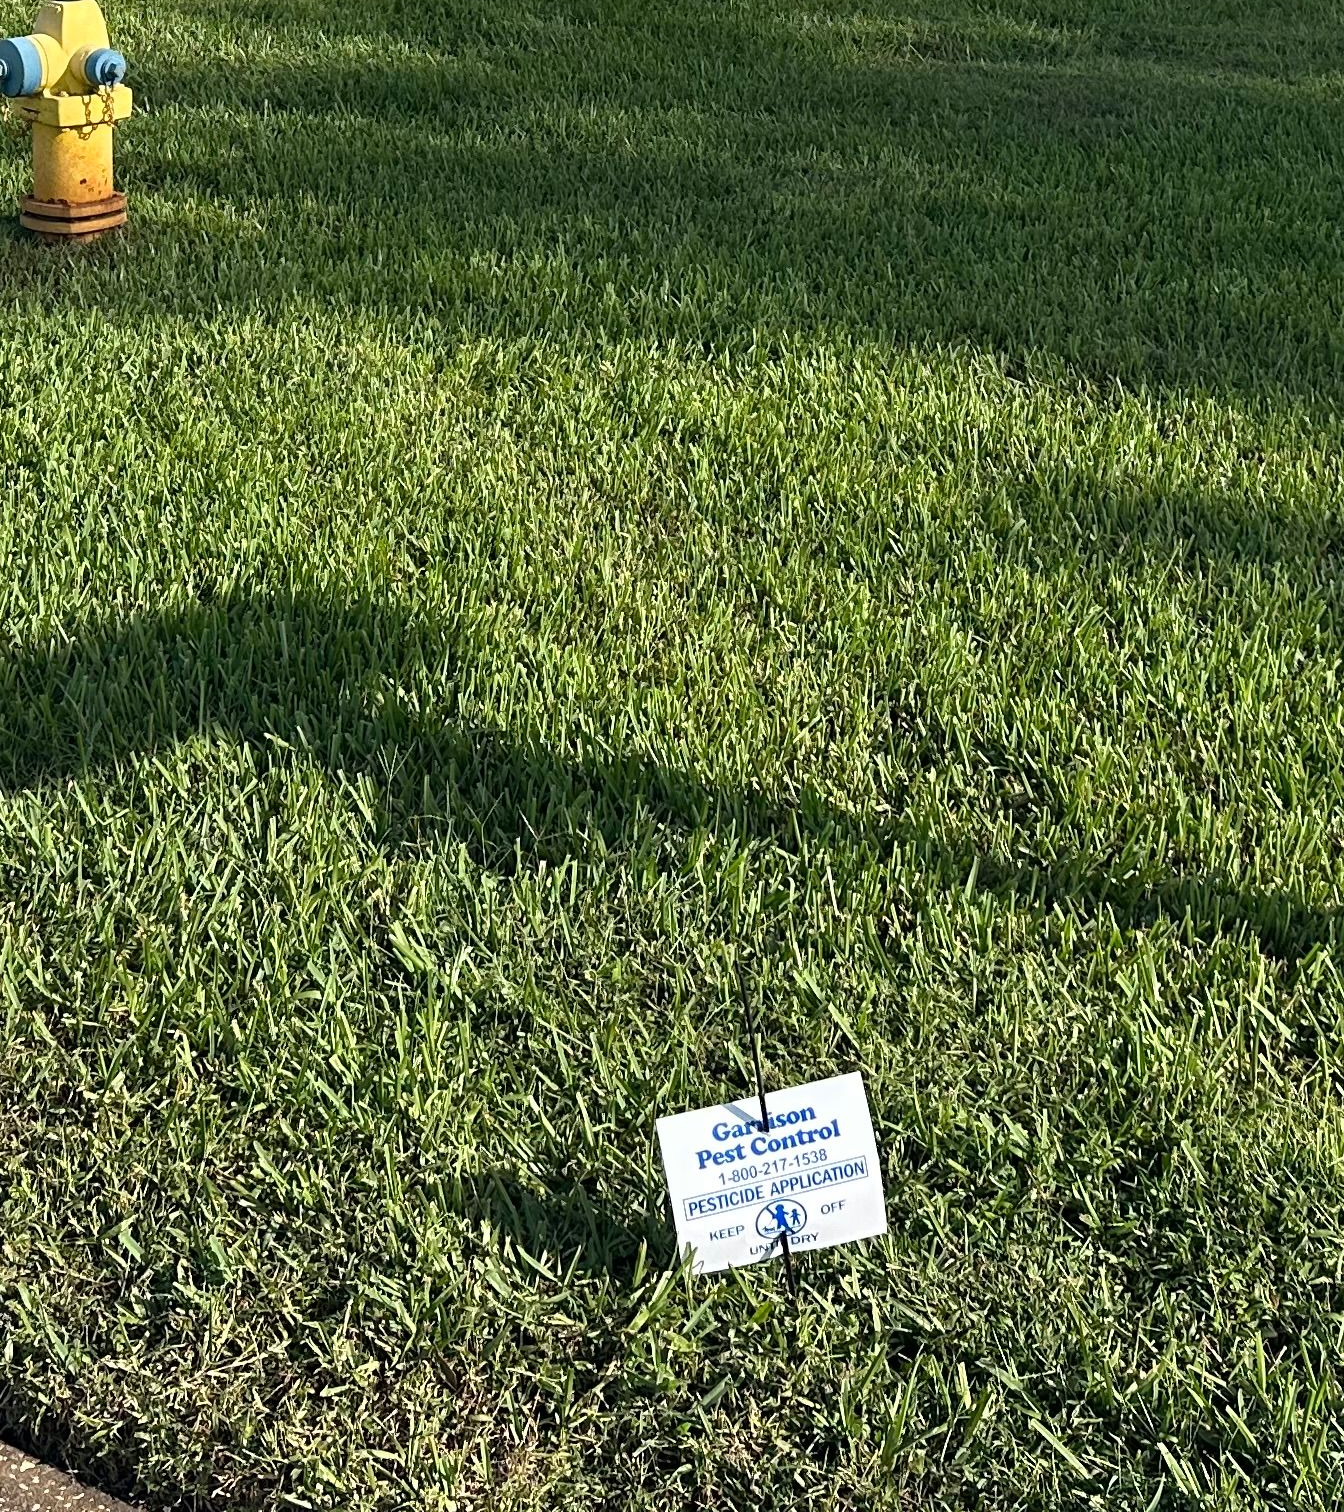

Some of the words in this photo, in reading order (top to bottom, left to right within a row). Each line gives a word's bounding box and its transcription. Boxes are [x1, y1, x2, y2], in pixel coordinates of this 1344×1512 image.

[695, 1143, 747, 1169] Pest
[750, 1118, 841, 1156] Control
[718, 1148, 828, 1186] 1-800-217-1538
[688, 1185, 765, 1217] PESTICIDE
[770, 1160, 866, 1197] APPLICATION
[709, 1224, 745, 1241] KEEP
[820, 1199, 847, 1215] OFF
[749, 1236, 784, 1255] UNTI
[790, 1232, 820, 1245] DRY
